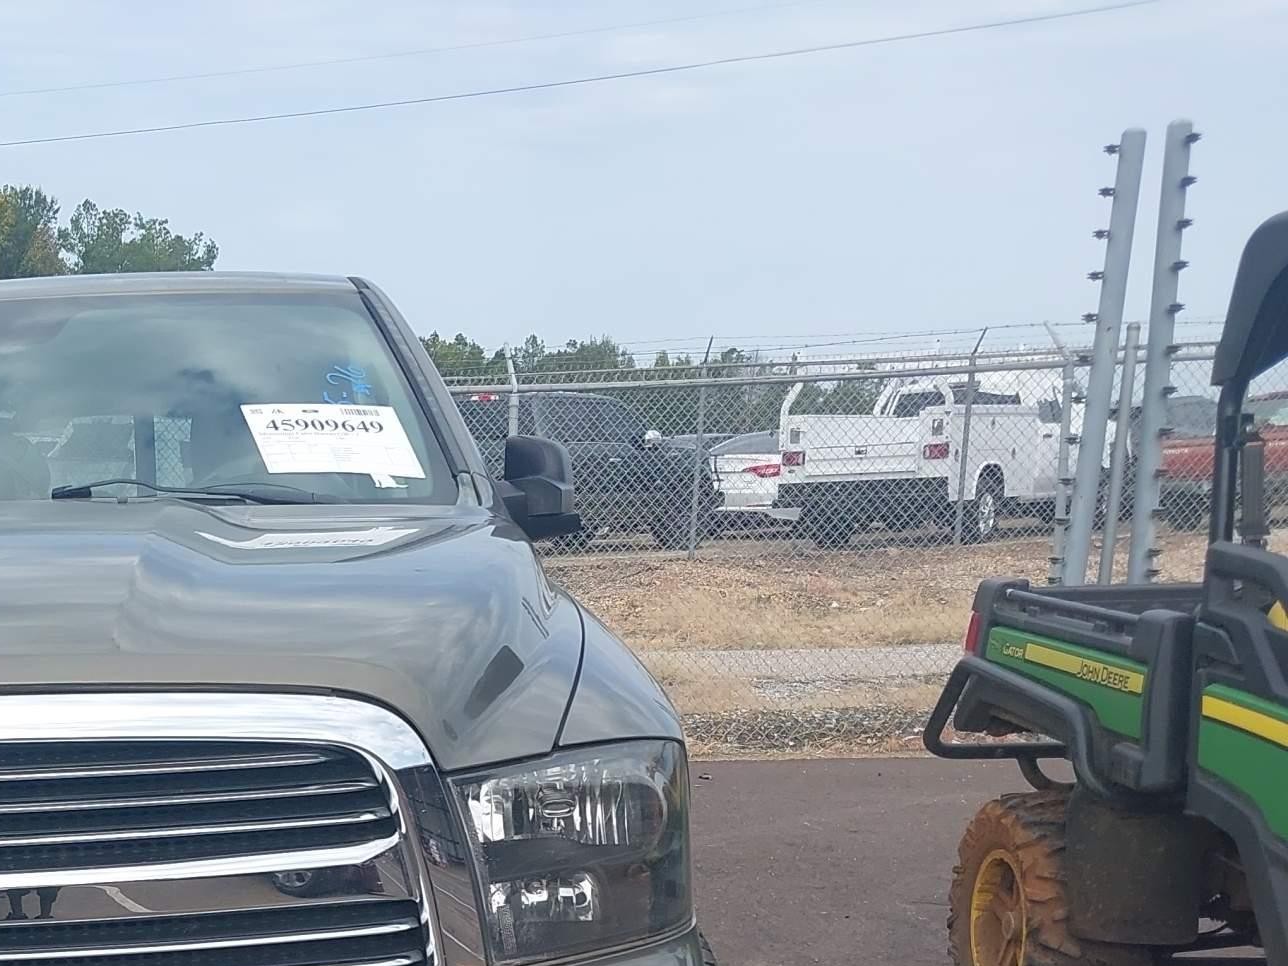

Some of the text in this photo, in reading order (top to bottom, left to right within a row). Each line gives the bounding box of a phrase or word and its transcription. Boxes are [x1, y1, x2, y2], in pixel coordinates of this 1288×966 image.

[265, 418, 384, 434] 45909649
[1002, 642, 1024, 658] GATOR
[1076, 659, 1131, 690] JOHN DEERE
